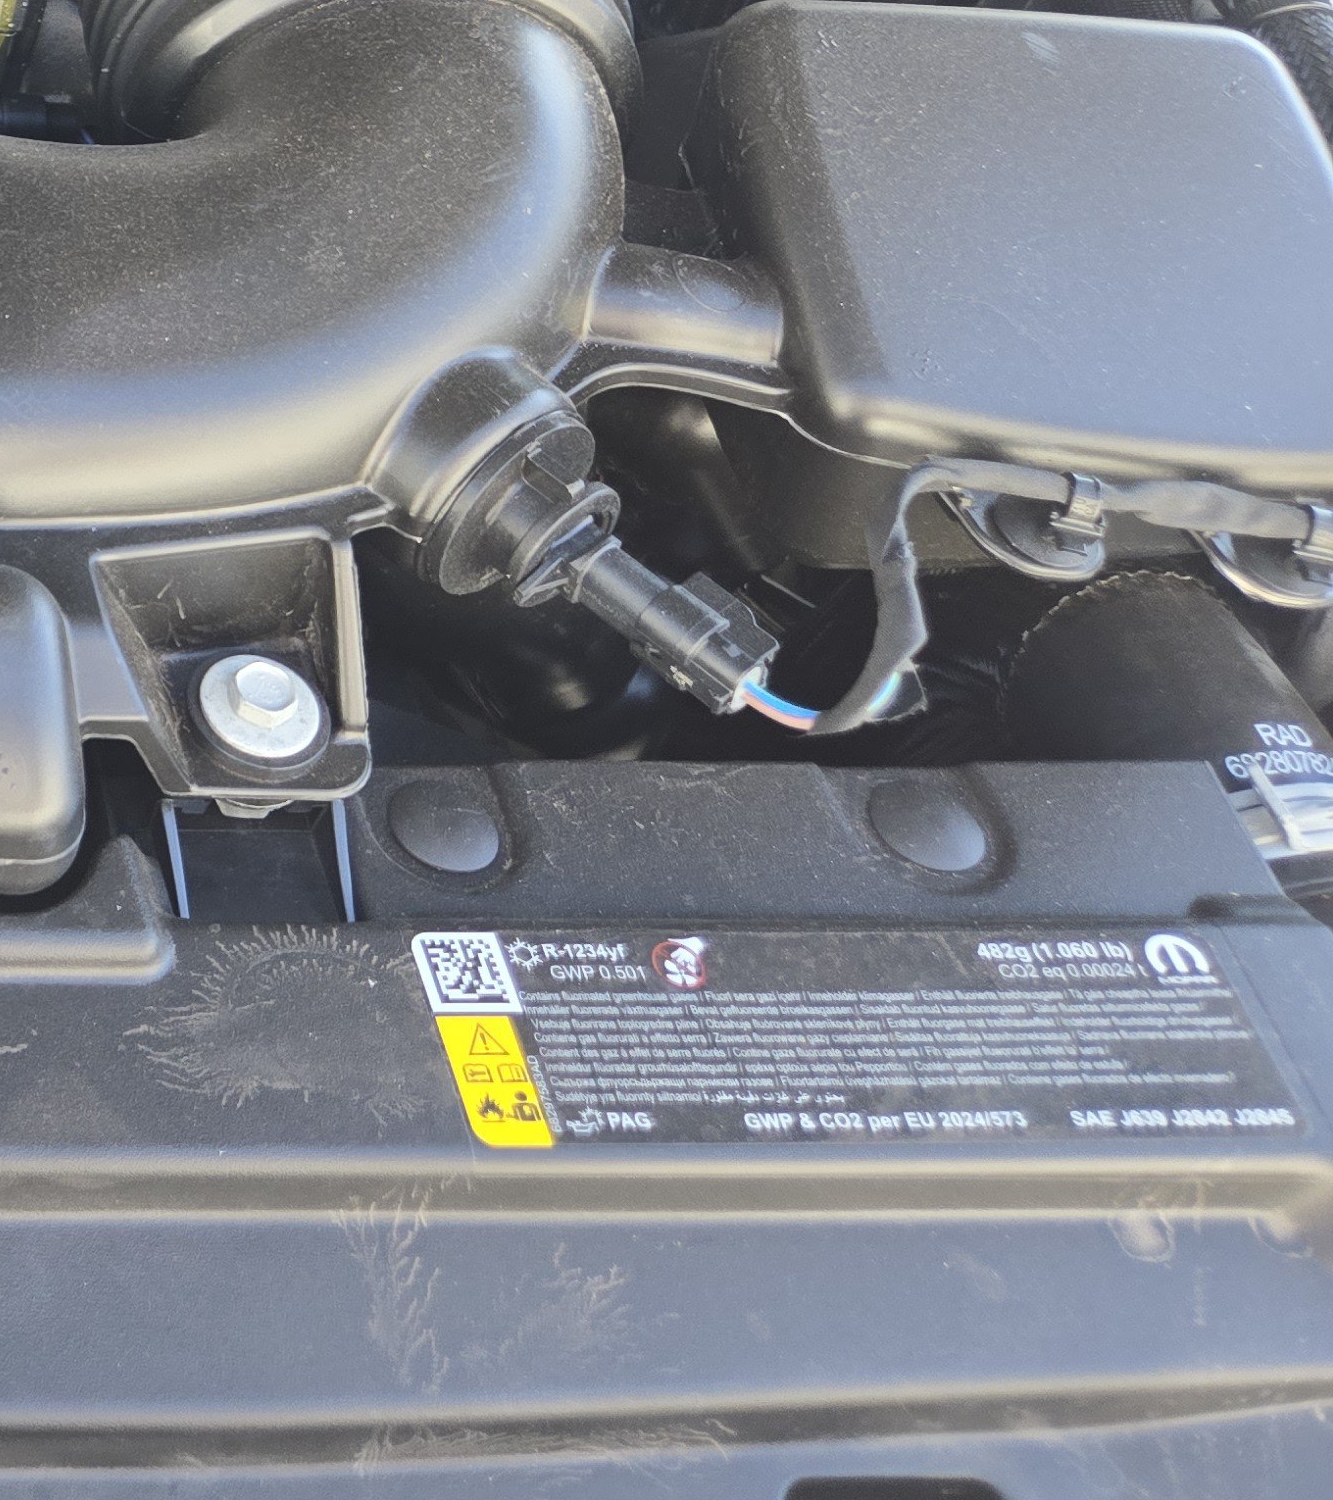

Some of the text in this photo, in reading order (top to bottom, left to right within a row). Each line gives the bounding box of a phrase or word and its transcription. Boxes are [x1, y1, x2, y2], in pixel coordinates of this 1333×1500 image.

[1254, 723, 1313, 748] RAD
[540, 942, 627, 962] R-1234yf
[977, 940, 1133, 963] 482g (1.060 lb)
[550, 964, 646, 983] GWP 0.501
[998, 963, 1039, 980] CO2
[1042, 966, 1068, 983] eq
[519, 991, 561, 1001] Contains
[561, 991, 610, 1001] fluorinated
[613, 991, 667, 1003] greenhouse
[670, 993, 698, 1003] gases
[606, 1112, 653, 1131] PAG
[744, 1110, 1028, 1133] GWP & CO2 per EU 2024/573
[1070, 1110, 1118, 1128] SAE
